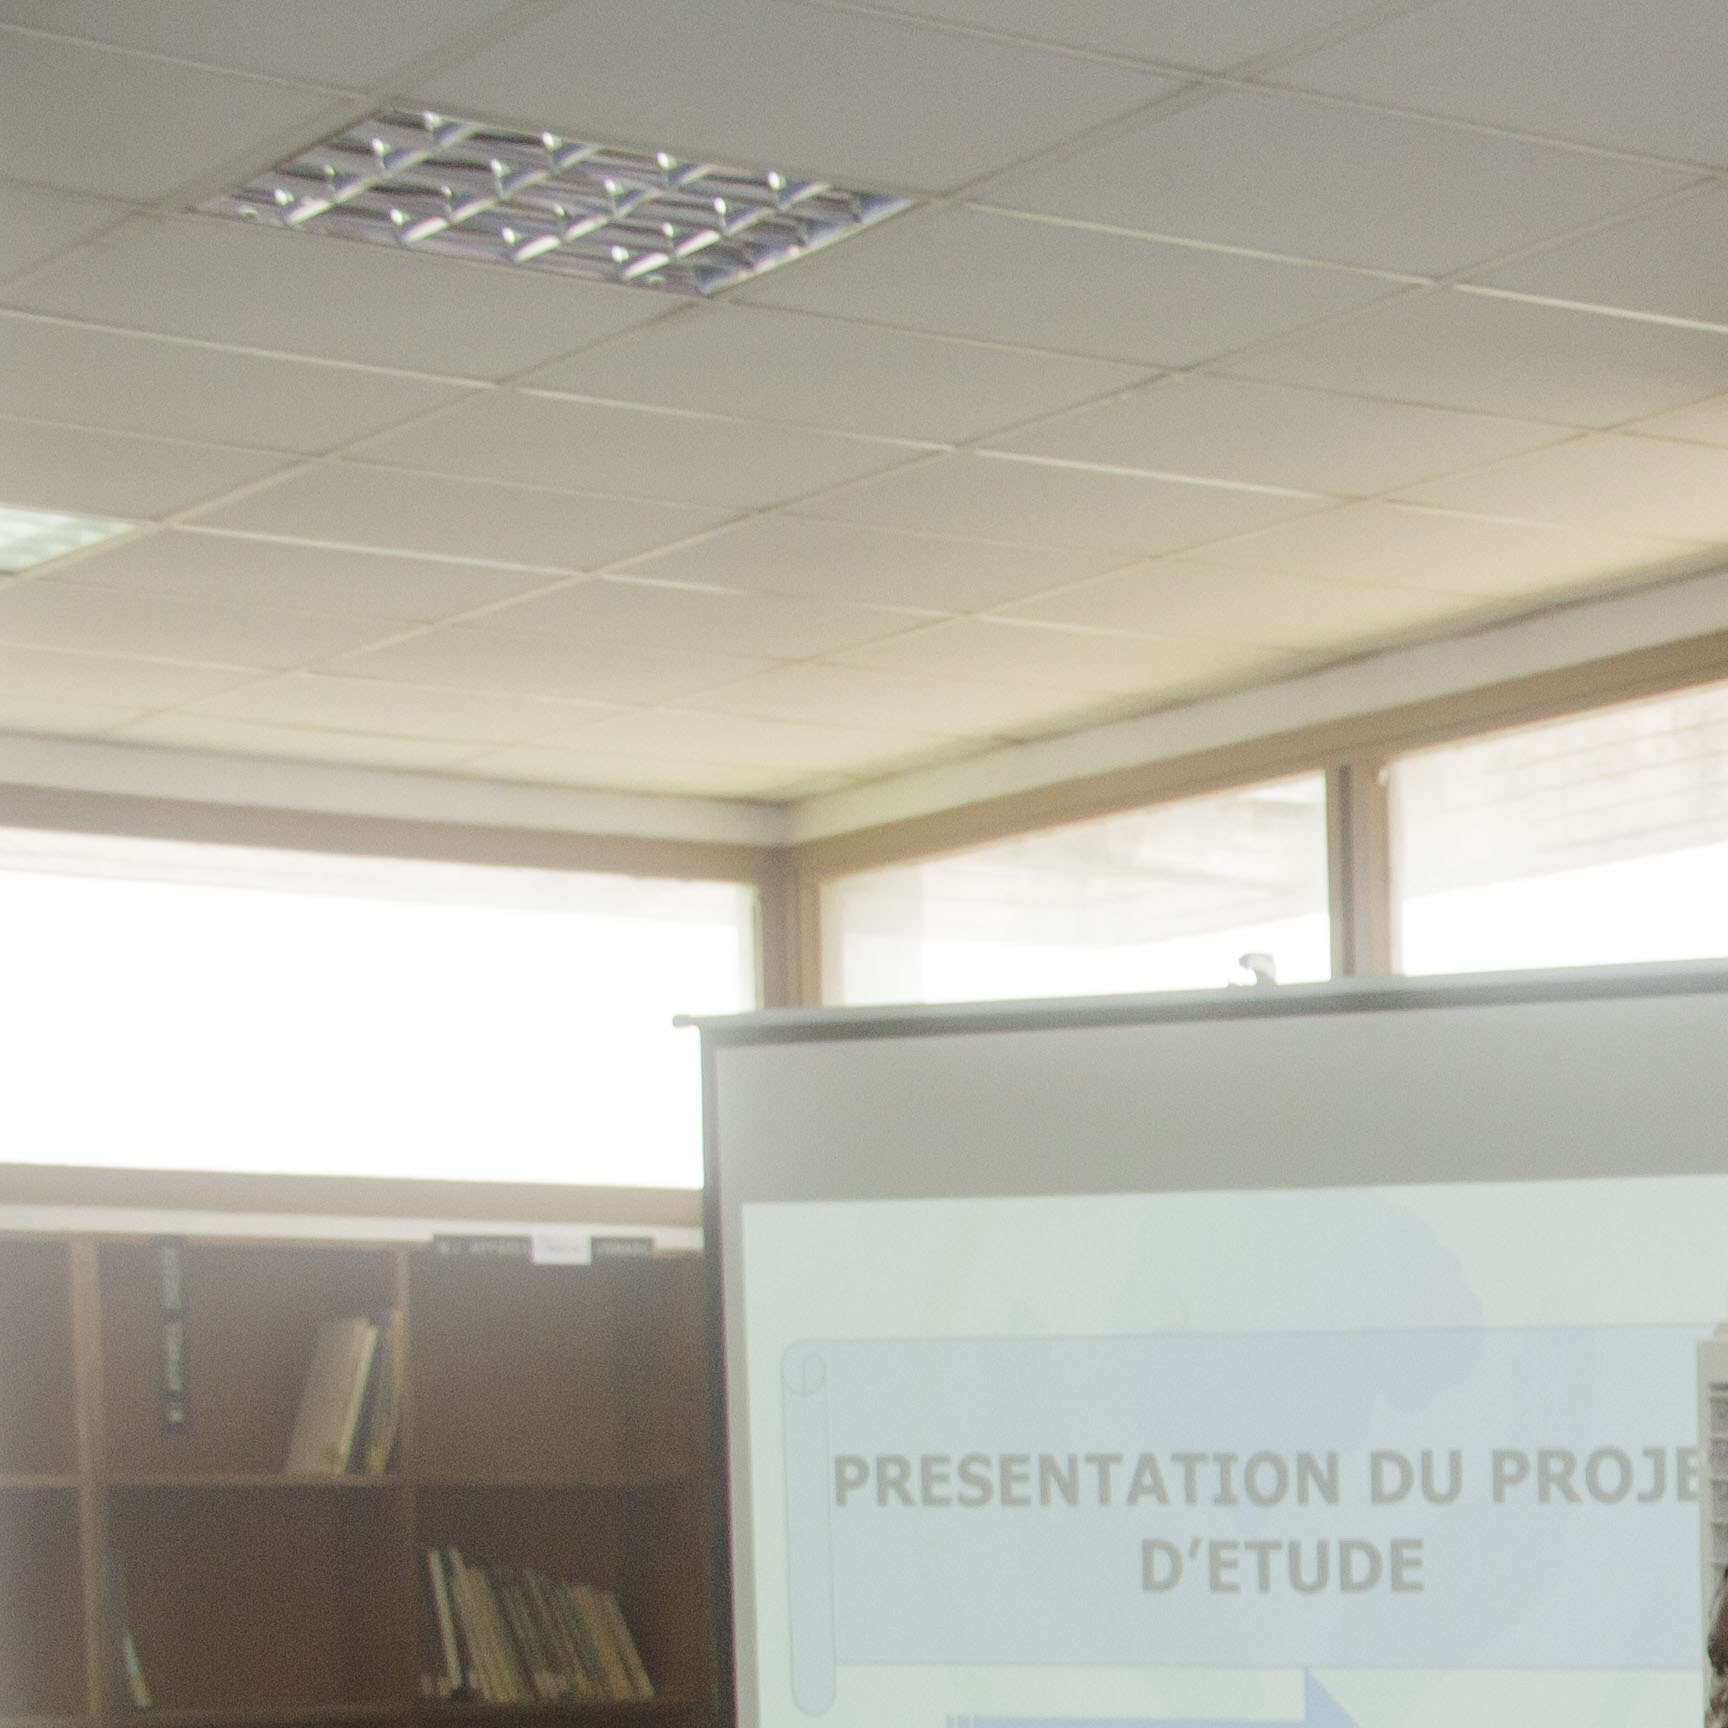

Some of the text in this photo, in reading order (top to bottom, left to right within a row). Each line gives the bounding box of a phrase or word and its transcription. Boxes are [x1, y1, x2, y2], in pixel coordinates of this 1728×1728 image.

[833, 1450, 1341, 1508] PRESENTATION
[1369, 1448, 1463, 1507] DU
[1140, 1537, 1425, 1595] D'ETUDE
